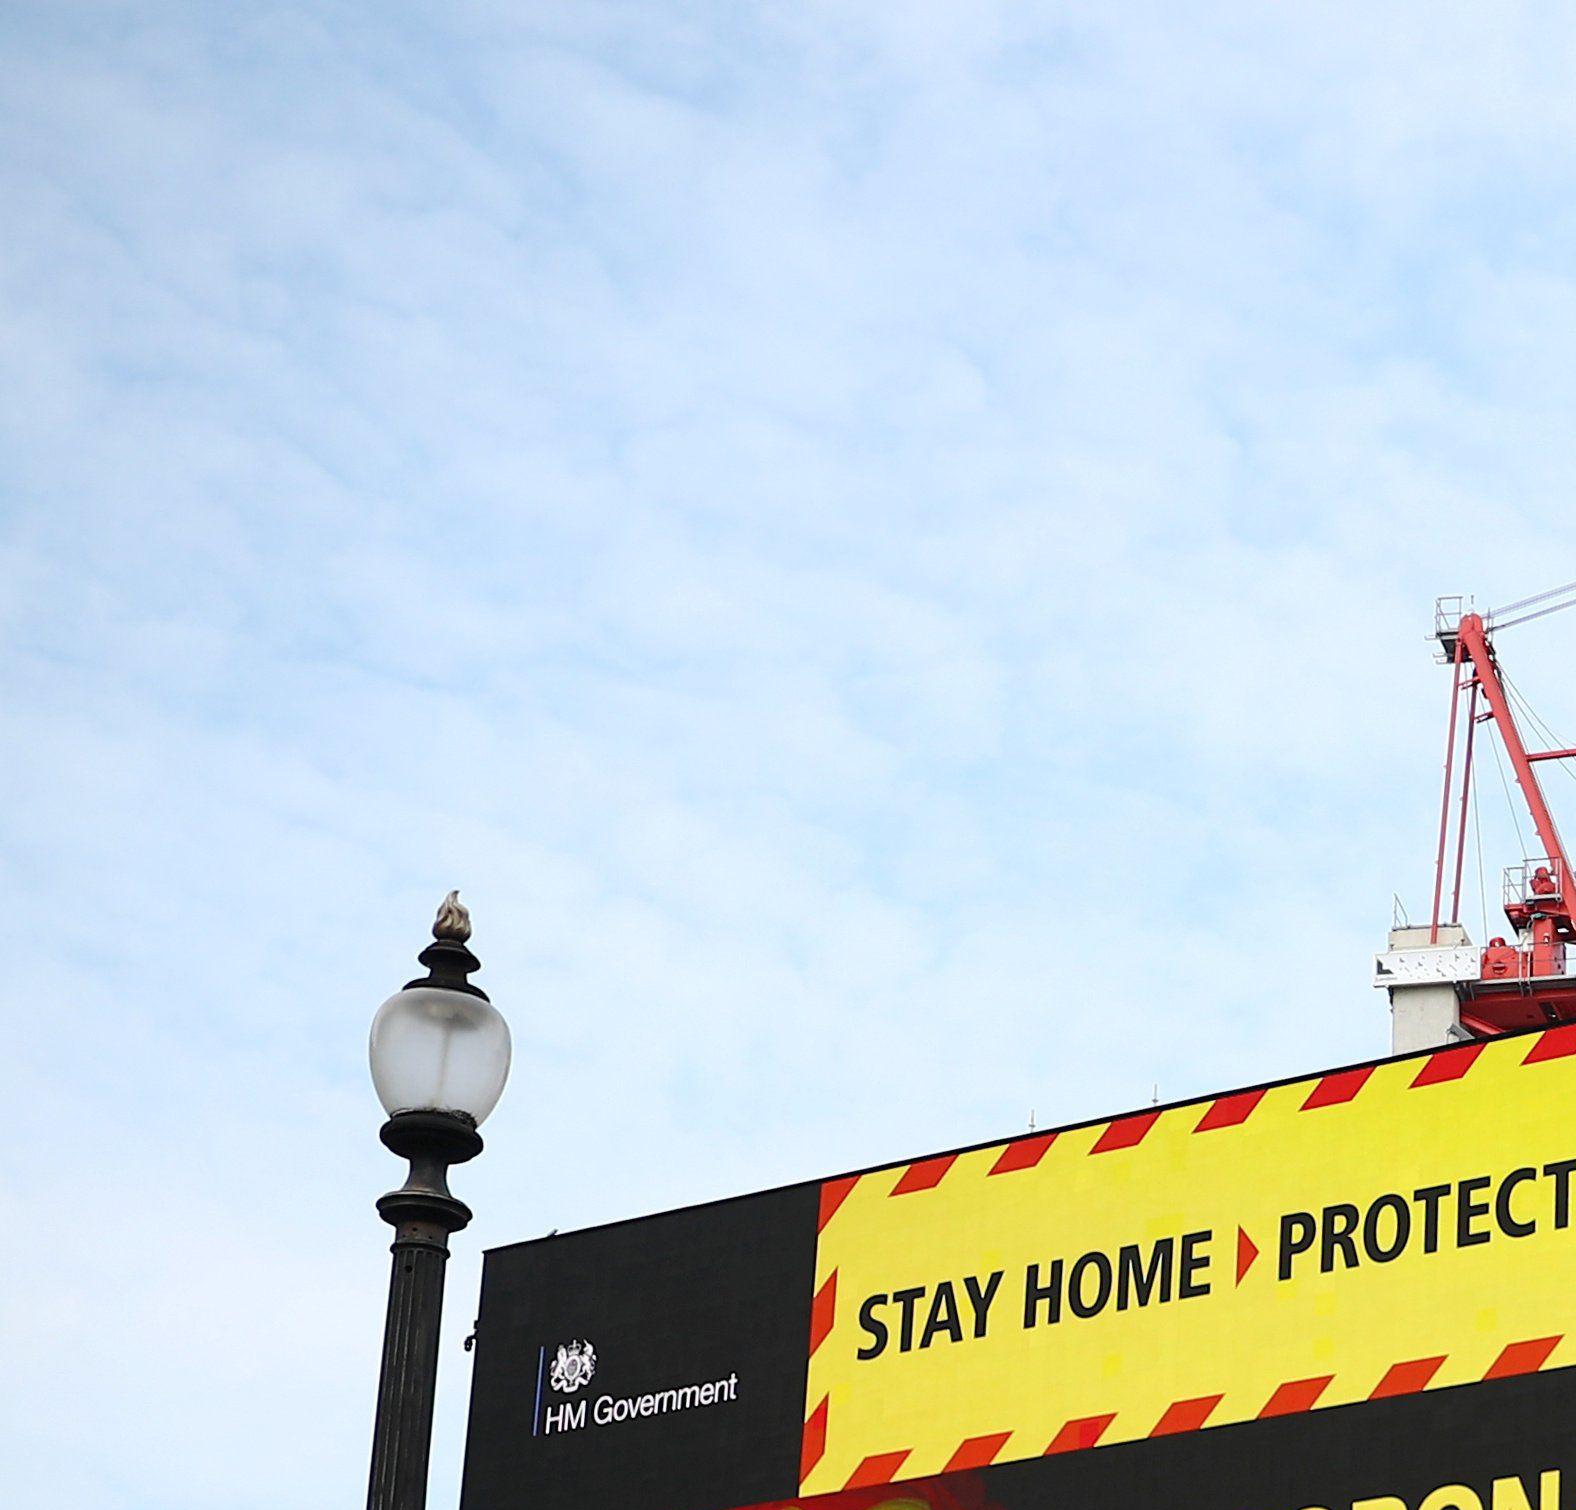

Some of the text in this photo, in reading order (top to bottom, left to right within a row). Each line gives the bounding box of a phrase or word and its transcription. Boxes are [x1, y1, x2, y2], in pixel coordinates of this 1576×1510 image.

[857, 1271, 1003, 1361] STAY
[1023, 1230, 1213, 1330] HOME
[545, 1372, 738, 1435] HM Government
